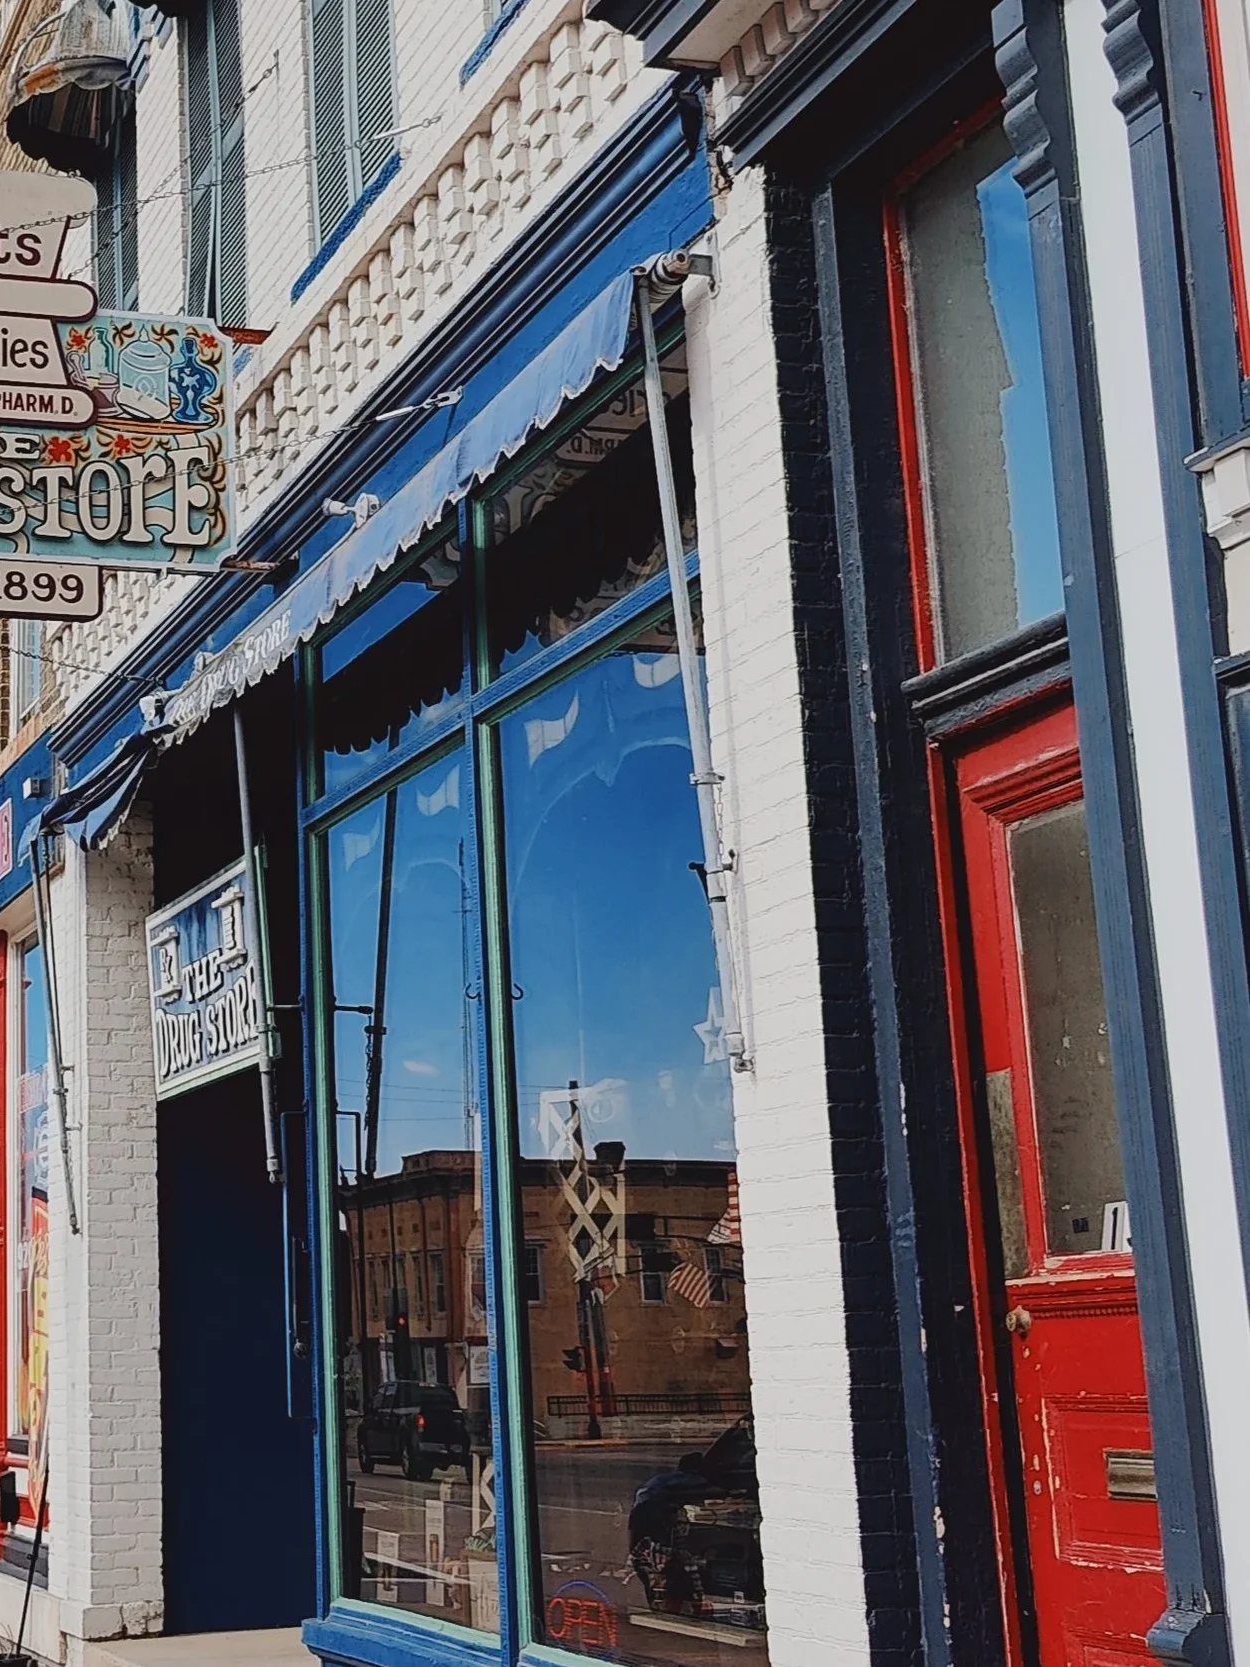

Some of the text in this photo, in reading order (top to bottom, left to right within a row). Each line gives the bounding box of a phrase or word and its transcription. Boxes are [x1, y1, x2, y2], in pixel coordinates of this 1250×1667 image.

[243, 609, 291, 675] STORE
[182, 947, 224, 1003] THE
[155, 1007, 201, 1078] DRUG
[547, 1597, 619, 1648] OPEN
